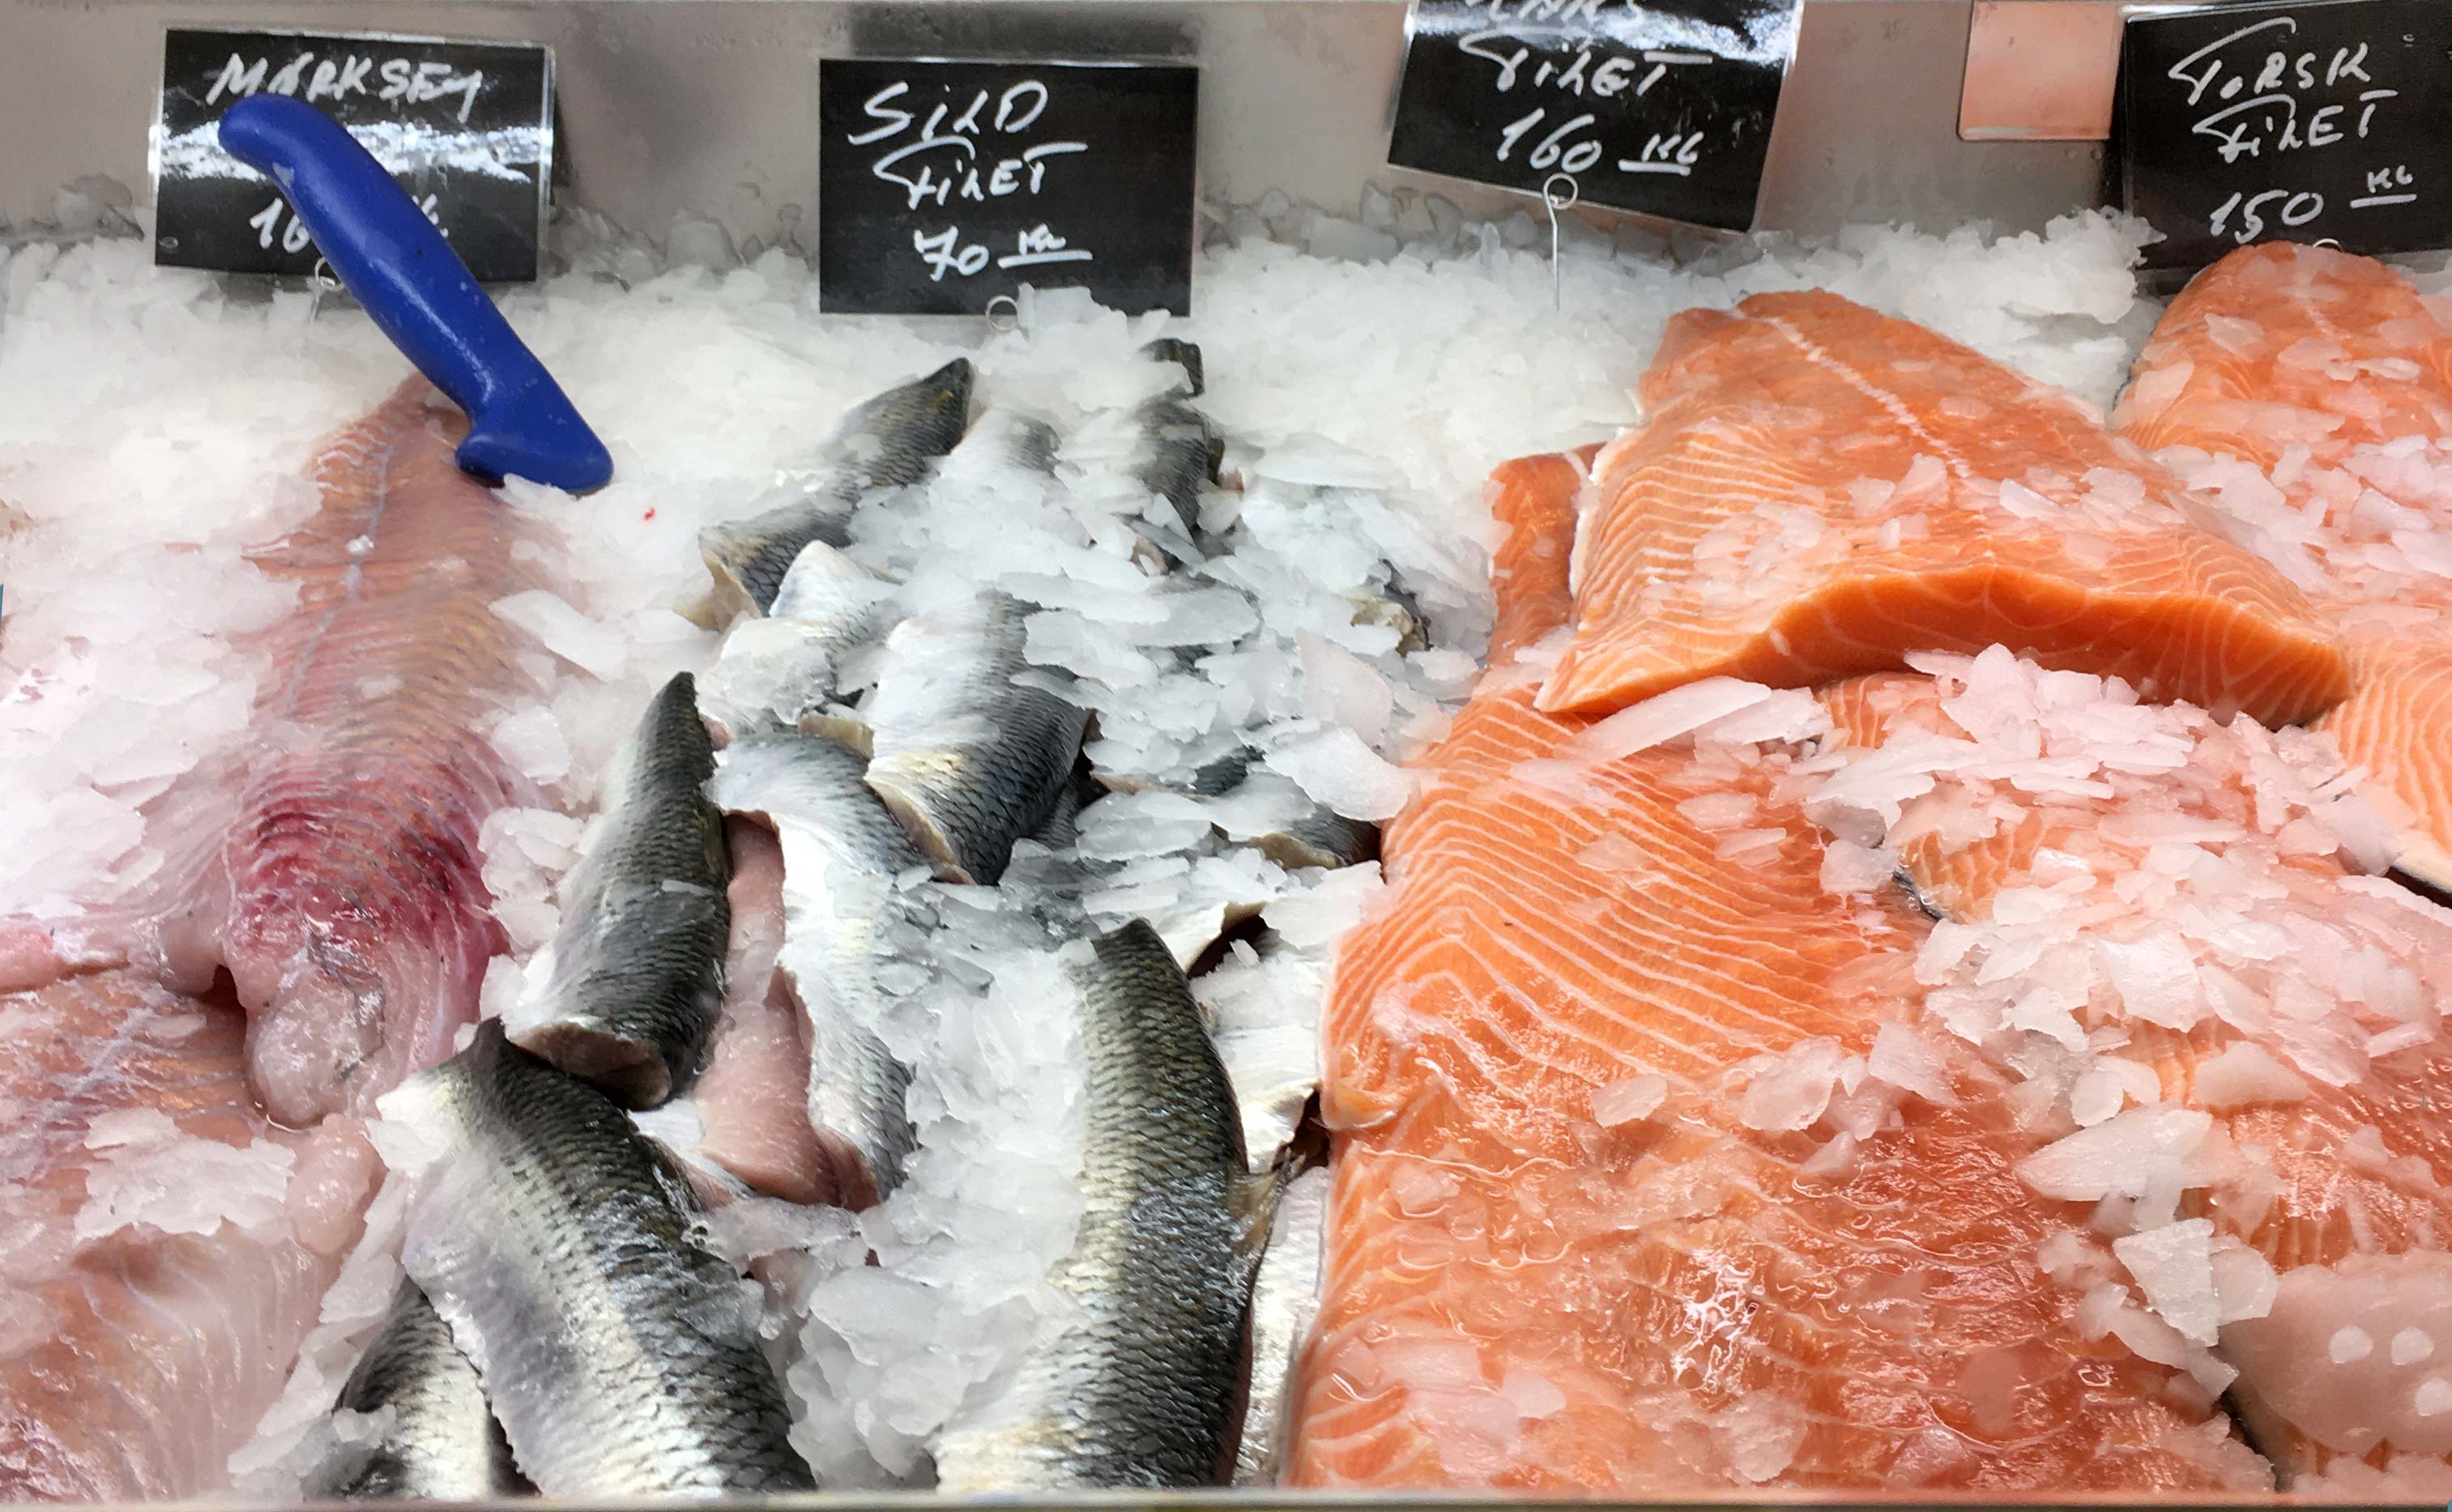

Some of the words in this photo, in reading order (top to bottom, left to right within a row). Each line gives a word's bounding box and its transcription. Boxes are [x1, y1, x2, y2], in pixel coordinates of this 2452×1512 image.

[1496, 108, 1603, 173] 160
[249, 197, 313, 253] 16
[2210, 190, 2325, 244] 150
[914, 225, 990, 282] 70
